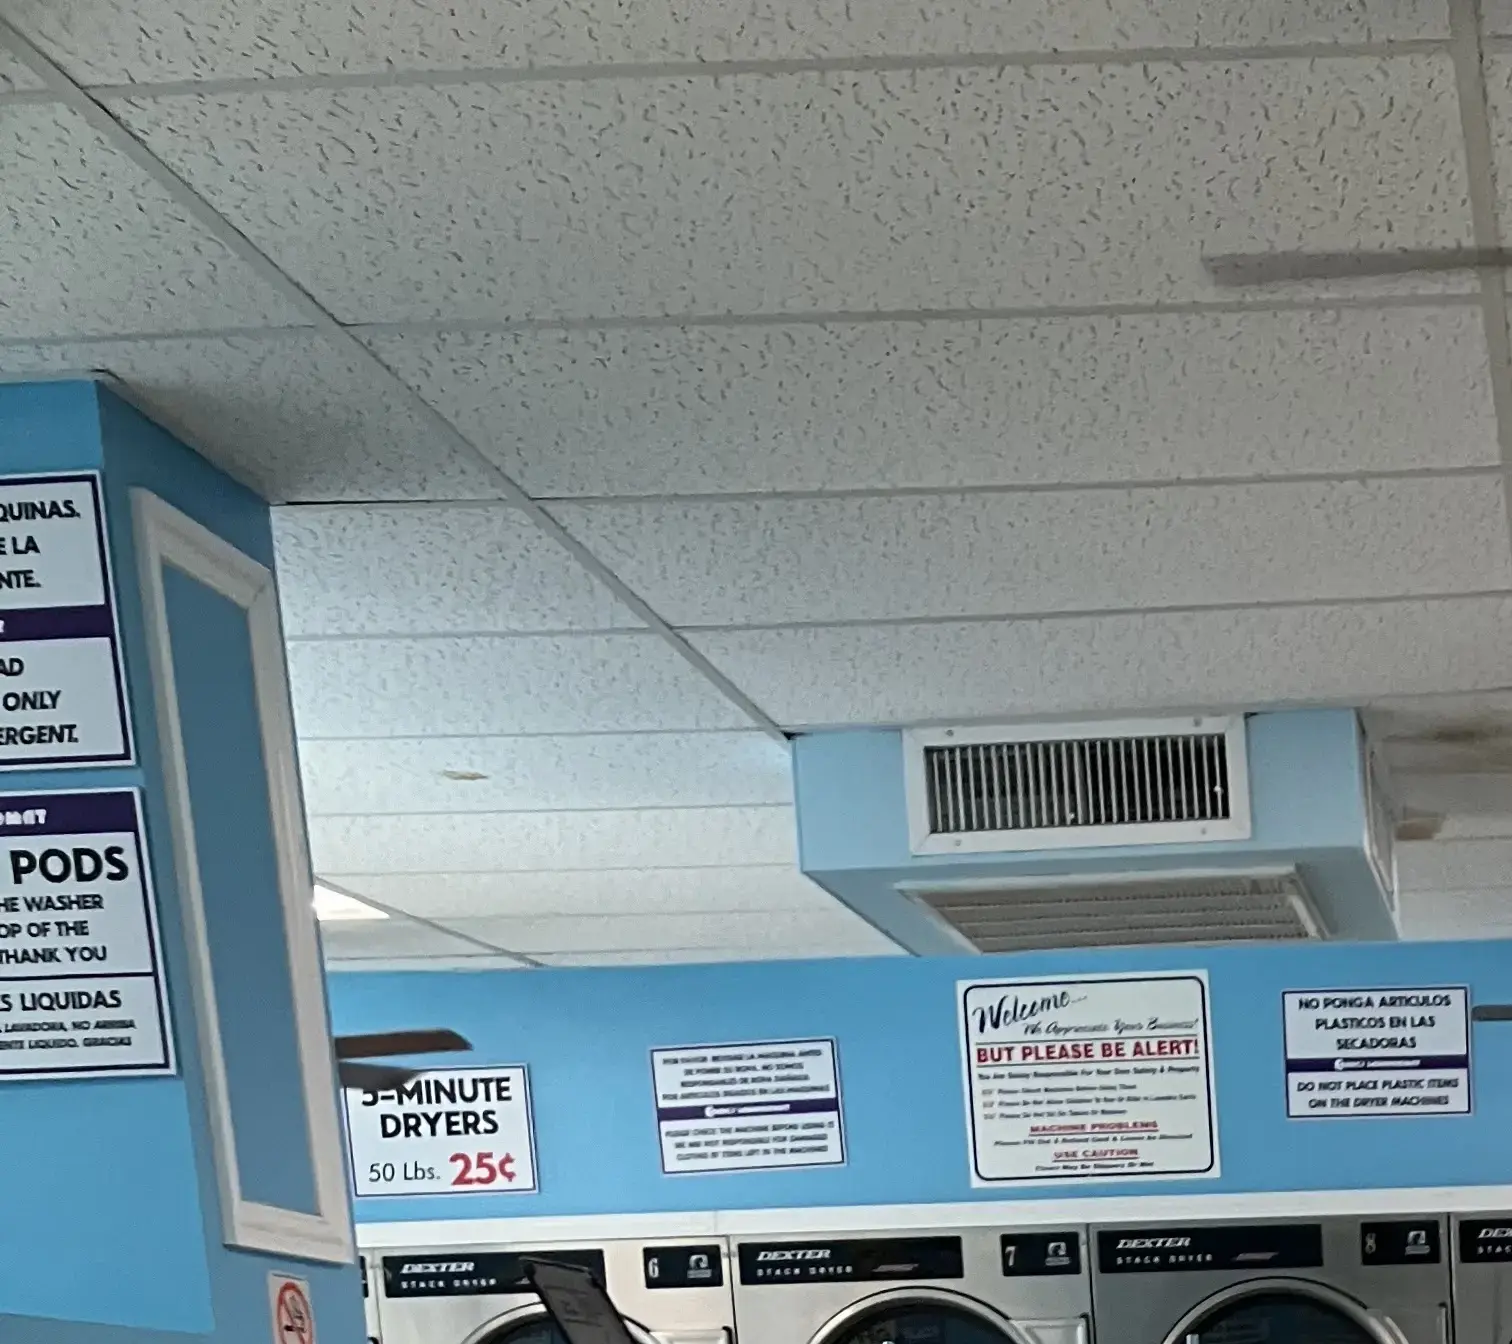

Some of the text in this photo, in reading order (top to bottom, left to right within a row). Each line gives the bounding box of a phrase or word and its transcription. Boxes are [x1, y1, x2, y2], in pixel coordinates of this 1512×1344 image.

[12, 535, 41, 554] LA
[3, 690, 61, 711] ONLY
[10, 846, 129, 884] PODS
[23, 894, 105, 912] WASHER
[27, 922, 51, 937] OF
[54, 920, 90, 936] THE
[64, 945, 108, 962] YOU
[20, 989, 122, 1011] LIQUIDAS
[1298, 993, 1452, 1011] NO PONGA ARTICULOS
[1315, 1015, 1436, 1031] PLASTICOS EN LAS
[976, 1037, 1200, 1064] BUT PLEASE BE ALERT!
[1336, 1035, 1418, 1051] SECADORAS
[1296, 1081, 1316, 1092] DO
[1318, 1080, 1343, 1092] NOT
[380, 1109, 499, 1139] DRYERS
[368, 1152, 517, 1186] 50 Lbs. 25¢
[1115, 1237, 1192, 1250] DEXTER
[756, 1249, 832, 1262] DEXTER
[1004, 1245, 1017, 1267] 7
[400, 1261, 476, 1274] DEXTER
[646, 1257, 660, 1278] 6
